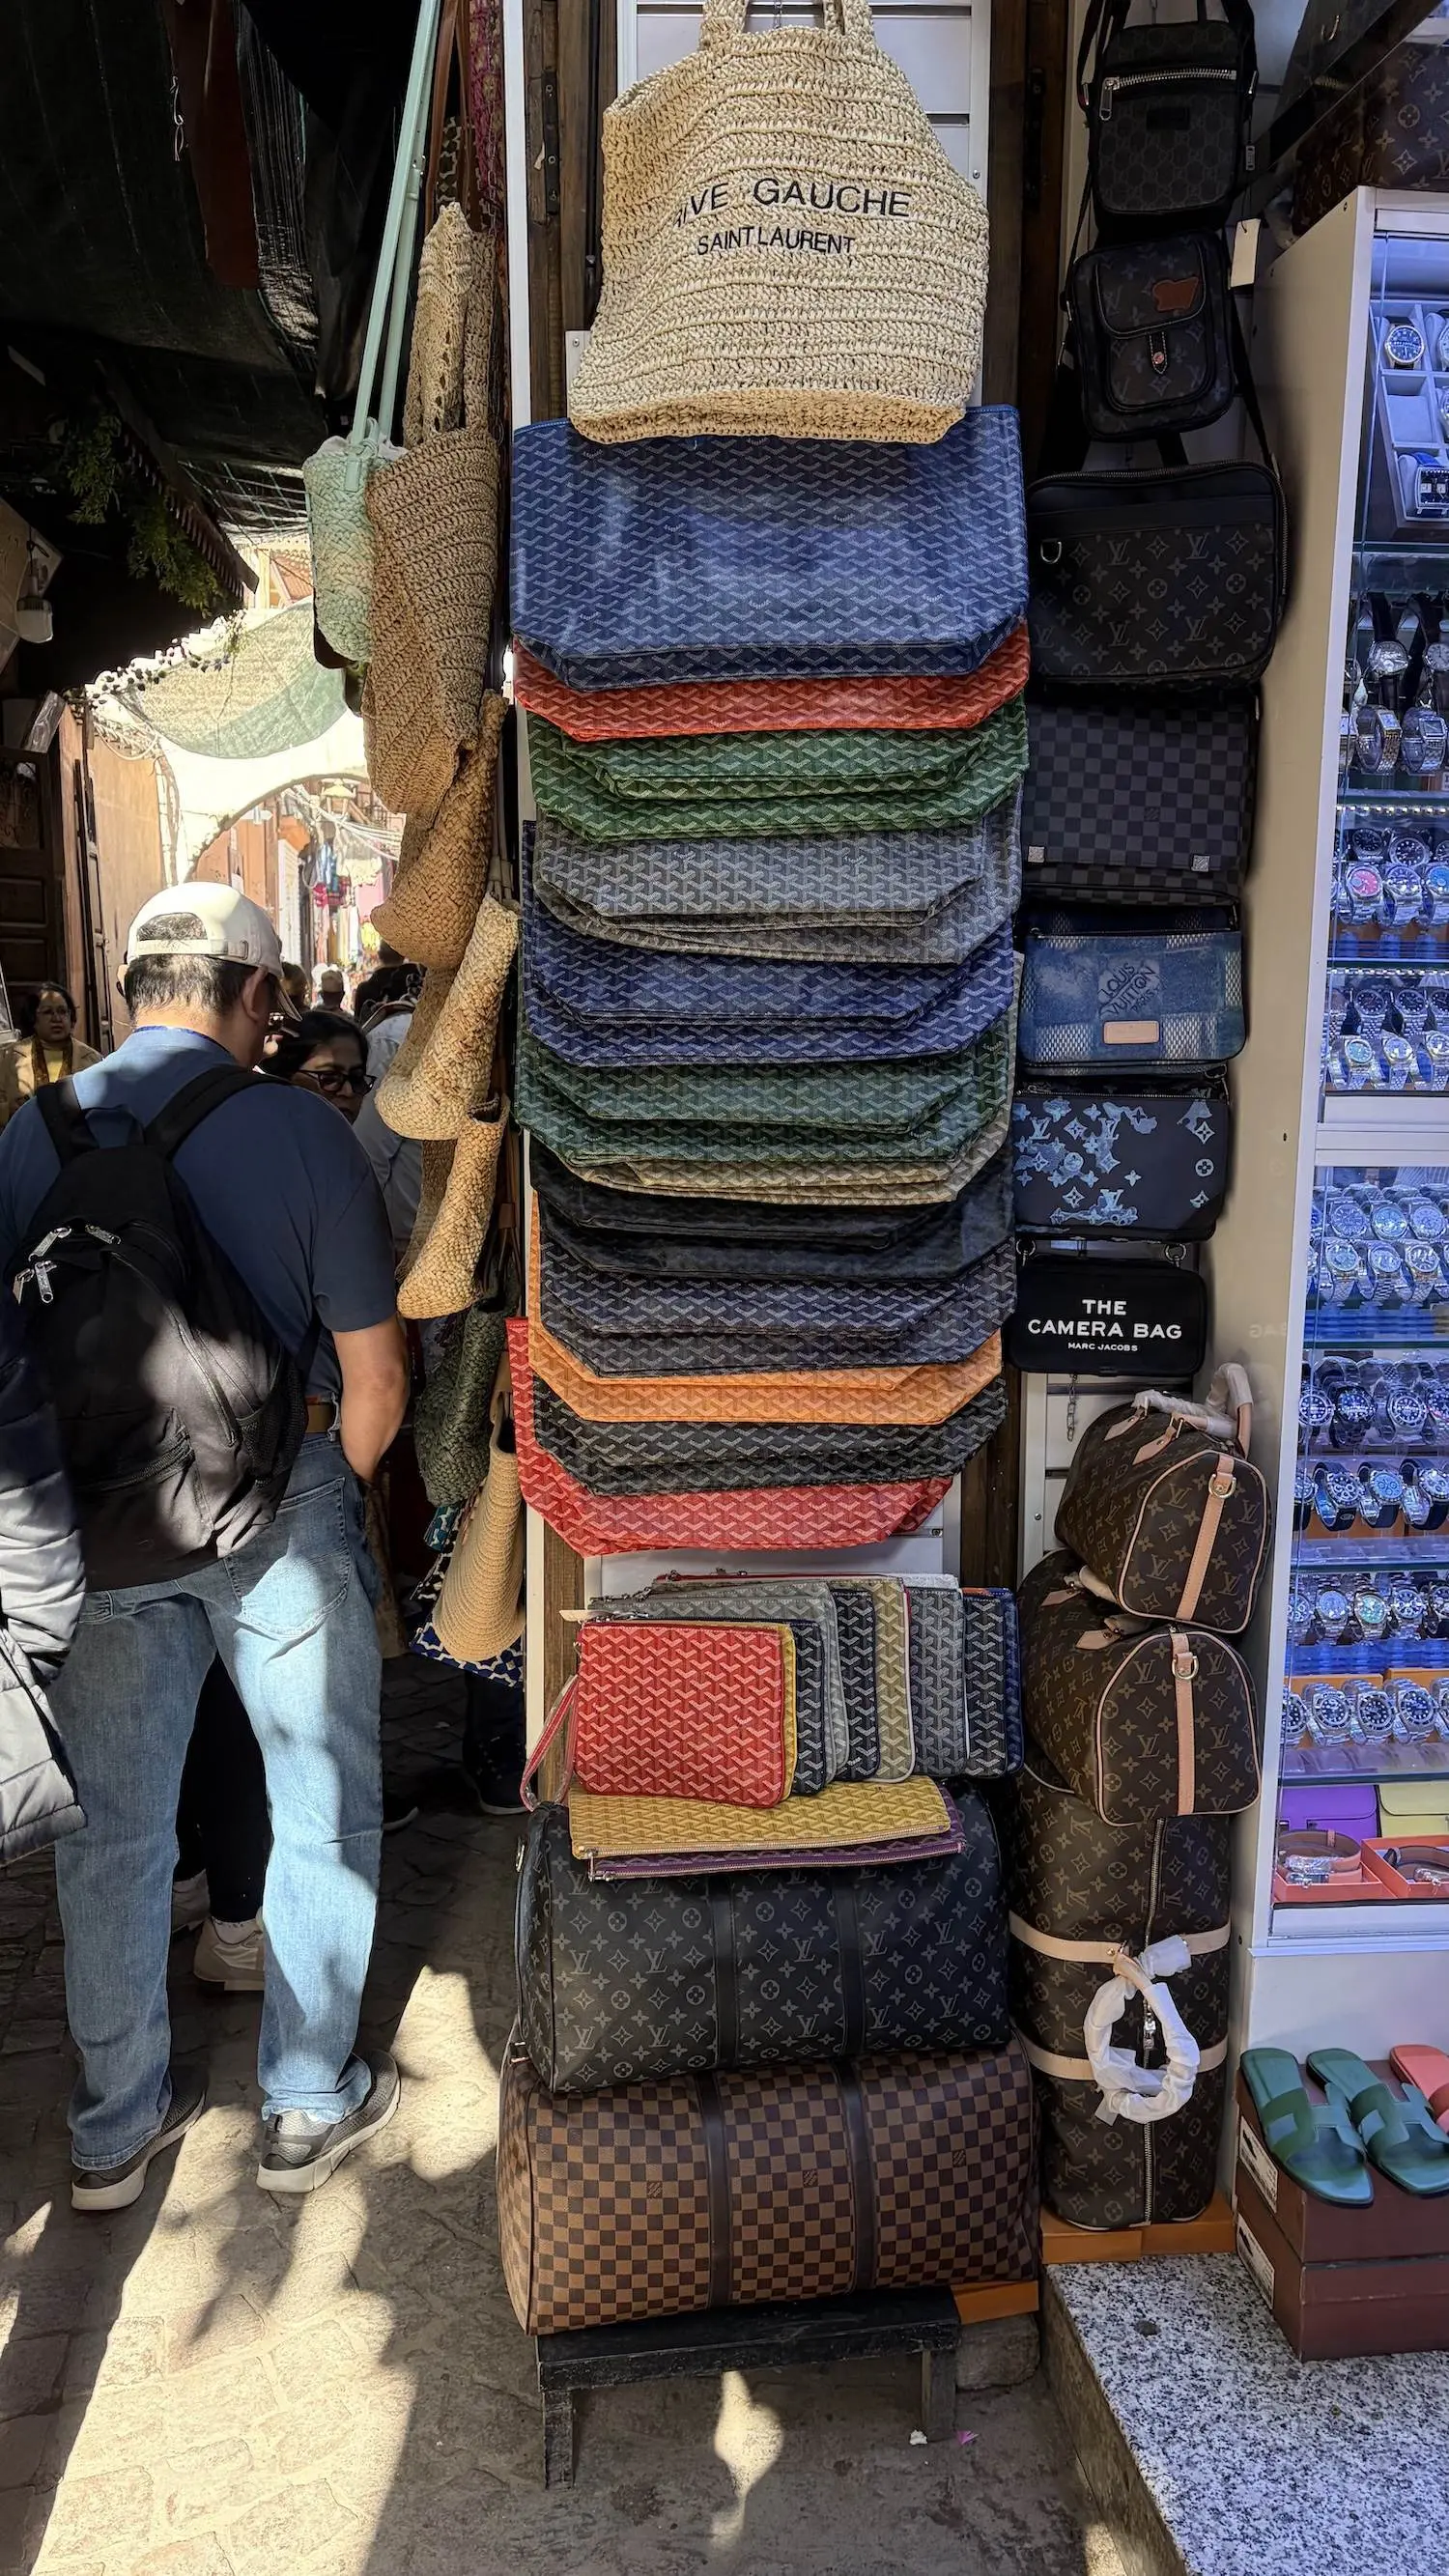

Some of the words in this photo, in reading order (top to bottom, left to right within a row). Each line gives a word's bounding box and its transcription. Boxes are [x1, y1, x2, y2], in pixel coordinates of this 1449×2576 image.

[753, 178, 911, 217] GAUCHE
[697, 226, 755, 255] SAINT
[758, 228, 855, 254] LAURENT
[1100, 962, 1135, 995] LOUIS
[1105, 966, 1156, 1014] VUITTON
[1082, 1299, 1126, 1316] THE
[1027, 1319, 1123, 1337] CAMERA
[1133, 1323, 1182, 1340] BAG
[1067, 1342, 1096, 1350] MARC
